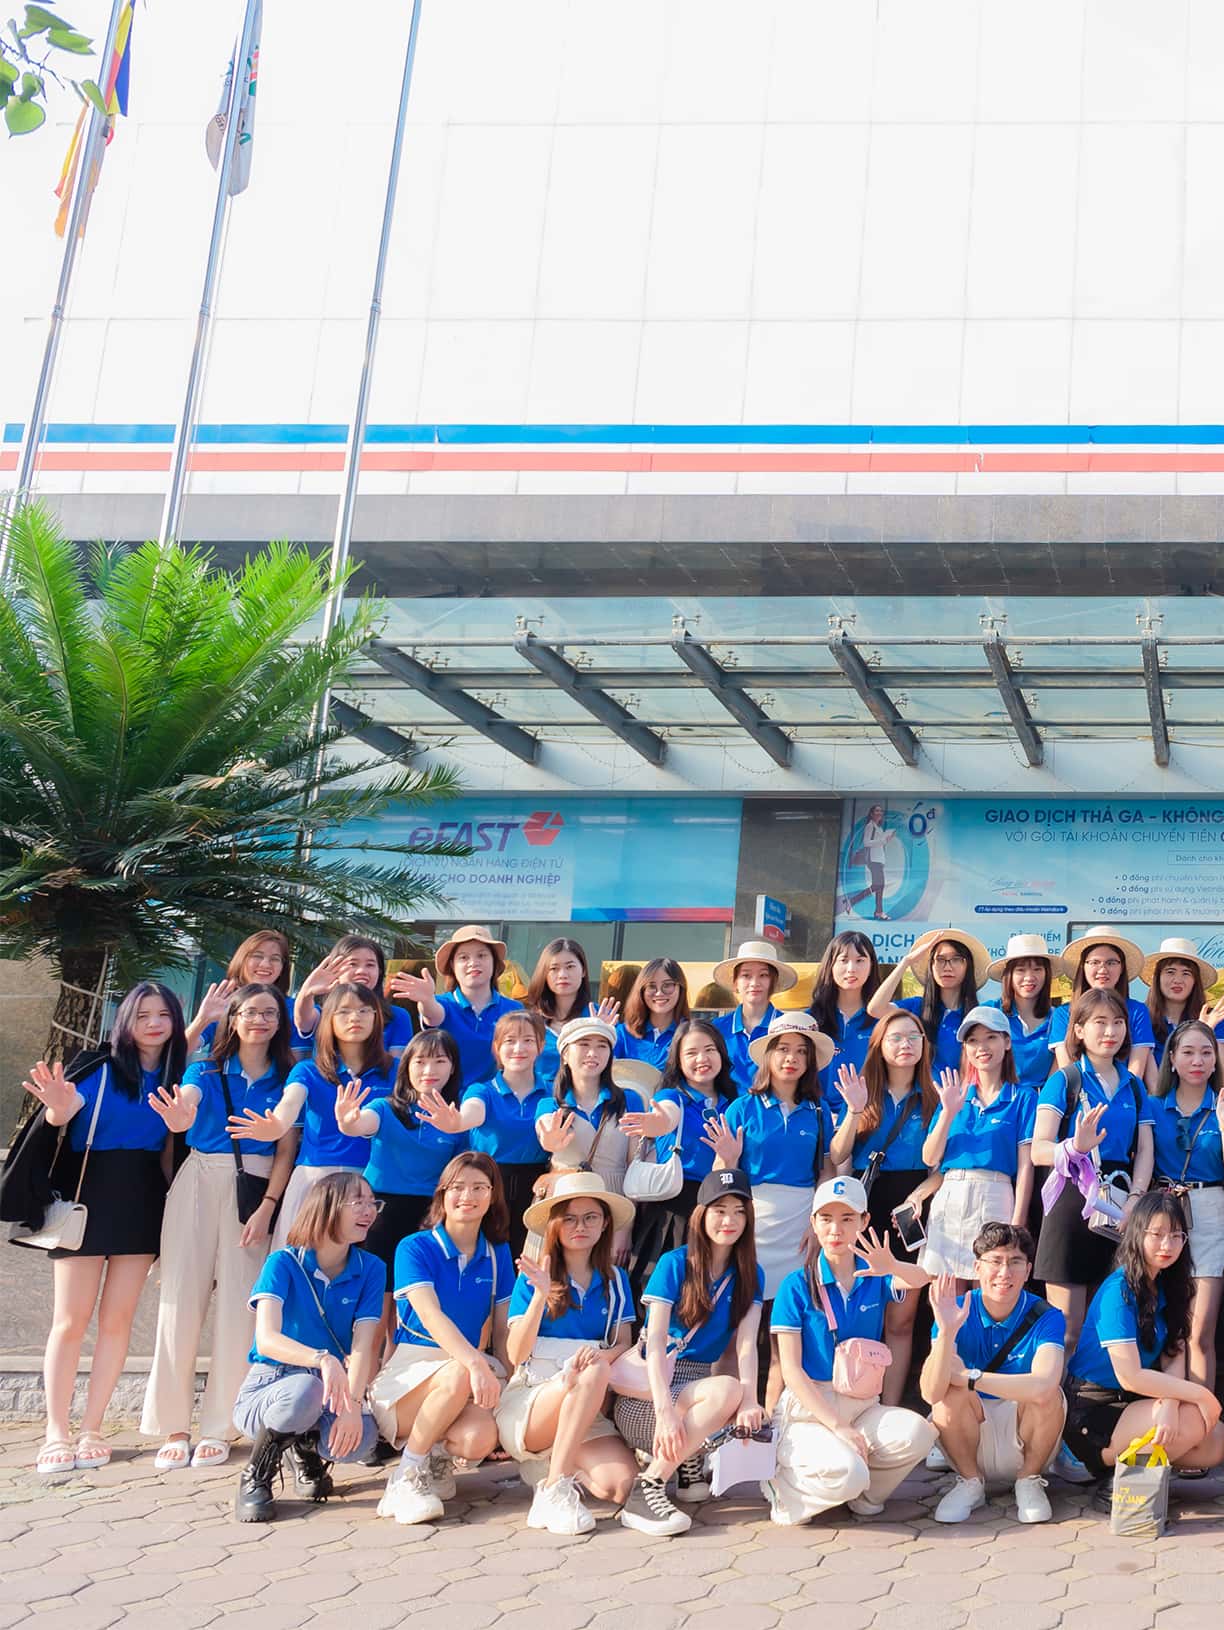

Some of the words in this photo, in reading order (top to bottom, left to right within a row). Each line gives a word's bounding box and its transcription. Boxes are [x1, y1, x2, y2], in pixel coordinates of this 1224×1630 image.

[985, 809, 1030, 823] GIAO
[1034, 809, 1076, 827] DỊCH
[1118, 809, 1144, 823] GA
[1162, 806, 1224, 824] KHÔNG
[409, 822, 520, 852] eFAST
[440, 873, 466, 884] CHO
[469, 873, 513, 884] DOANH
[517, 872, 561, 887] NGHIỆP
[872, 933, 915, 952] DỊCH
[833, 1180, 847, 1195] C
